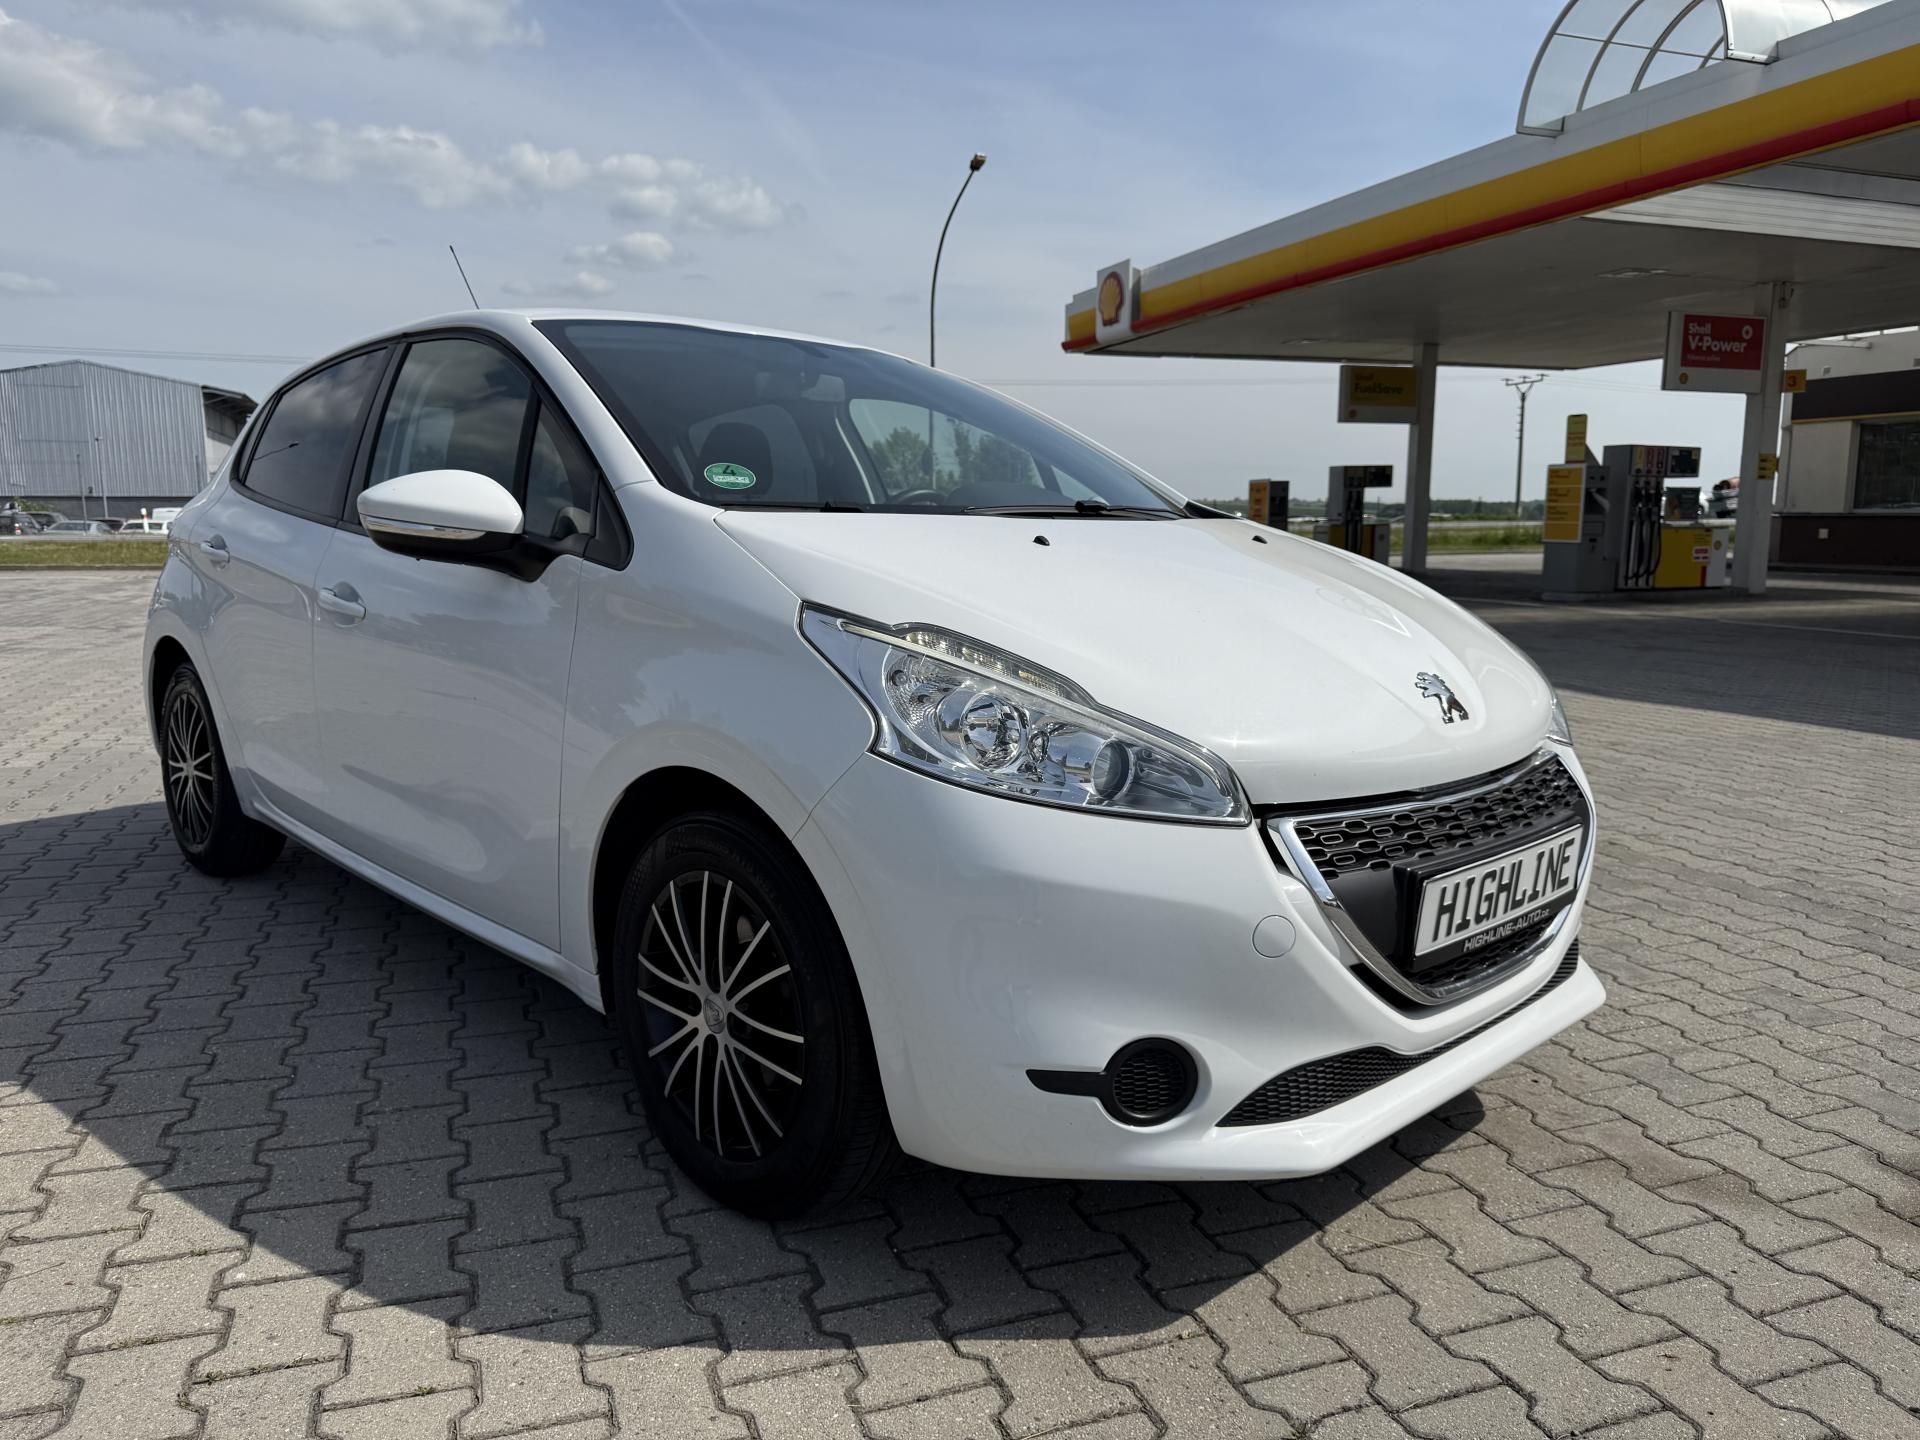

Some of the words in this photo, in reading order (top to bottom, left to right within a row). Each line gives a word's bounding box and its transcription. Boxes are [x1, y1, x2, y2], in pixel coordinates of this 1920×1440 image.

[1687, 322, 1712, 335] Shell
[1688, 335, 1747, 353] V-Power
[1786, 375, 1797, 388] 3
[722, 465, 736, 476] 4
[1433, 837, 1576, 942] HIGHLINE
